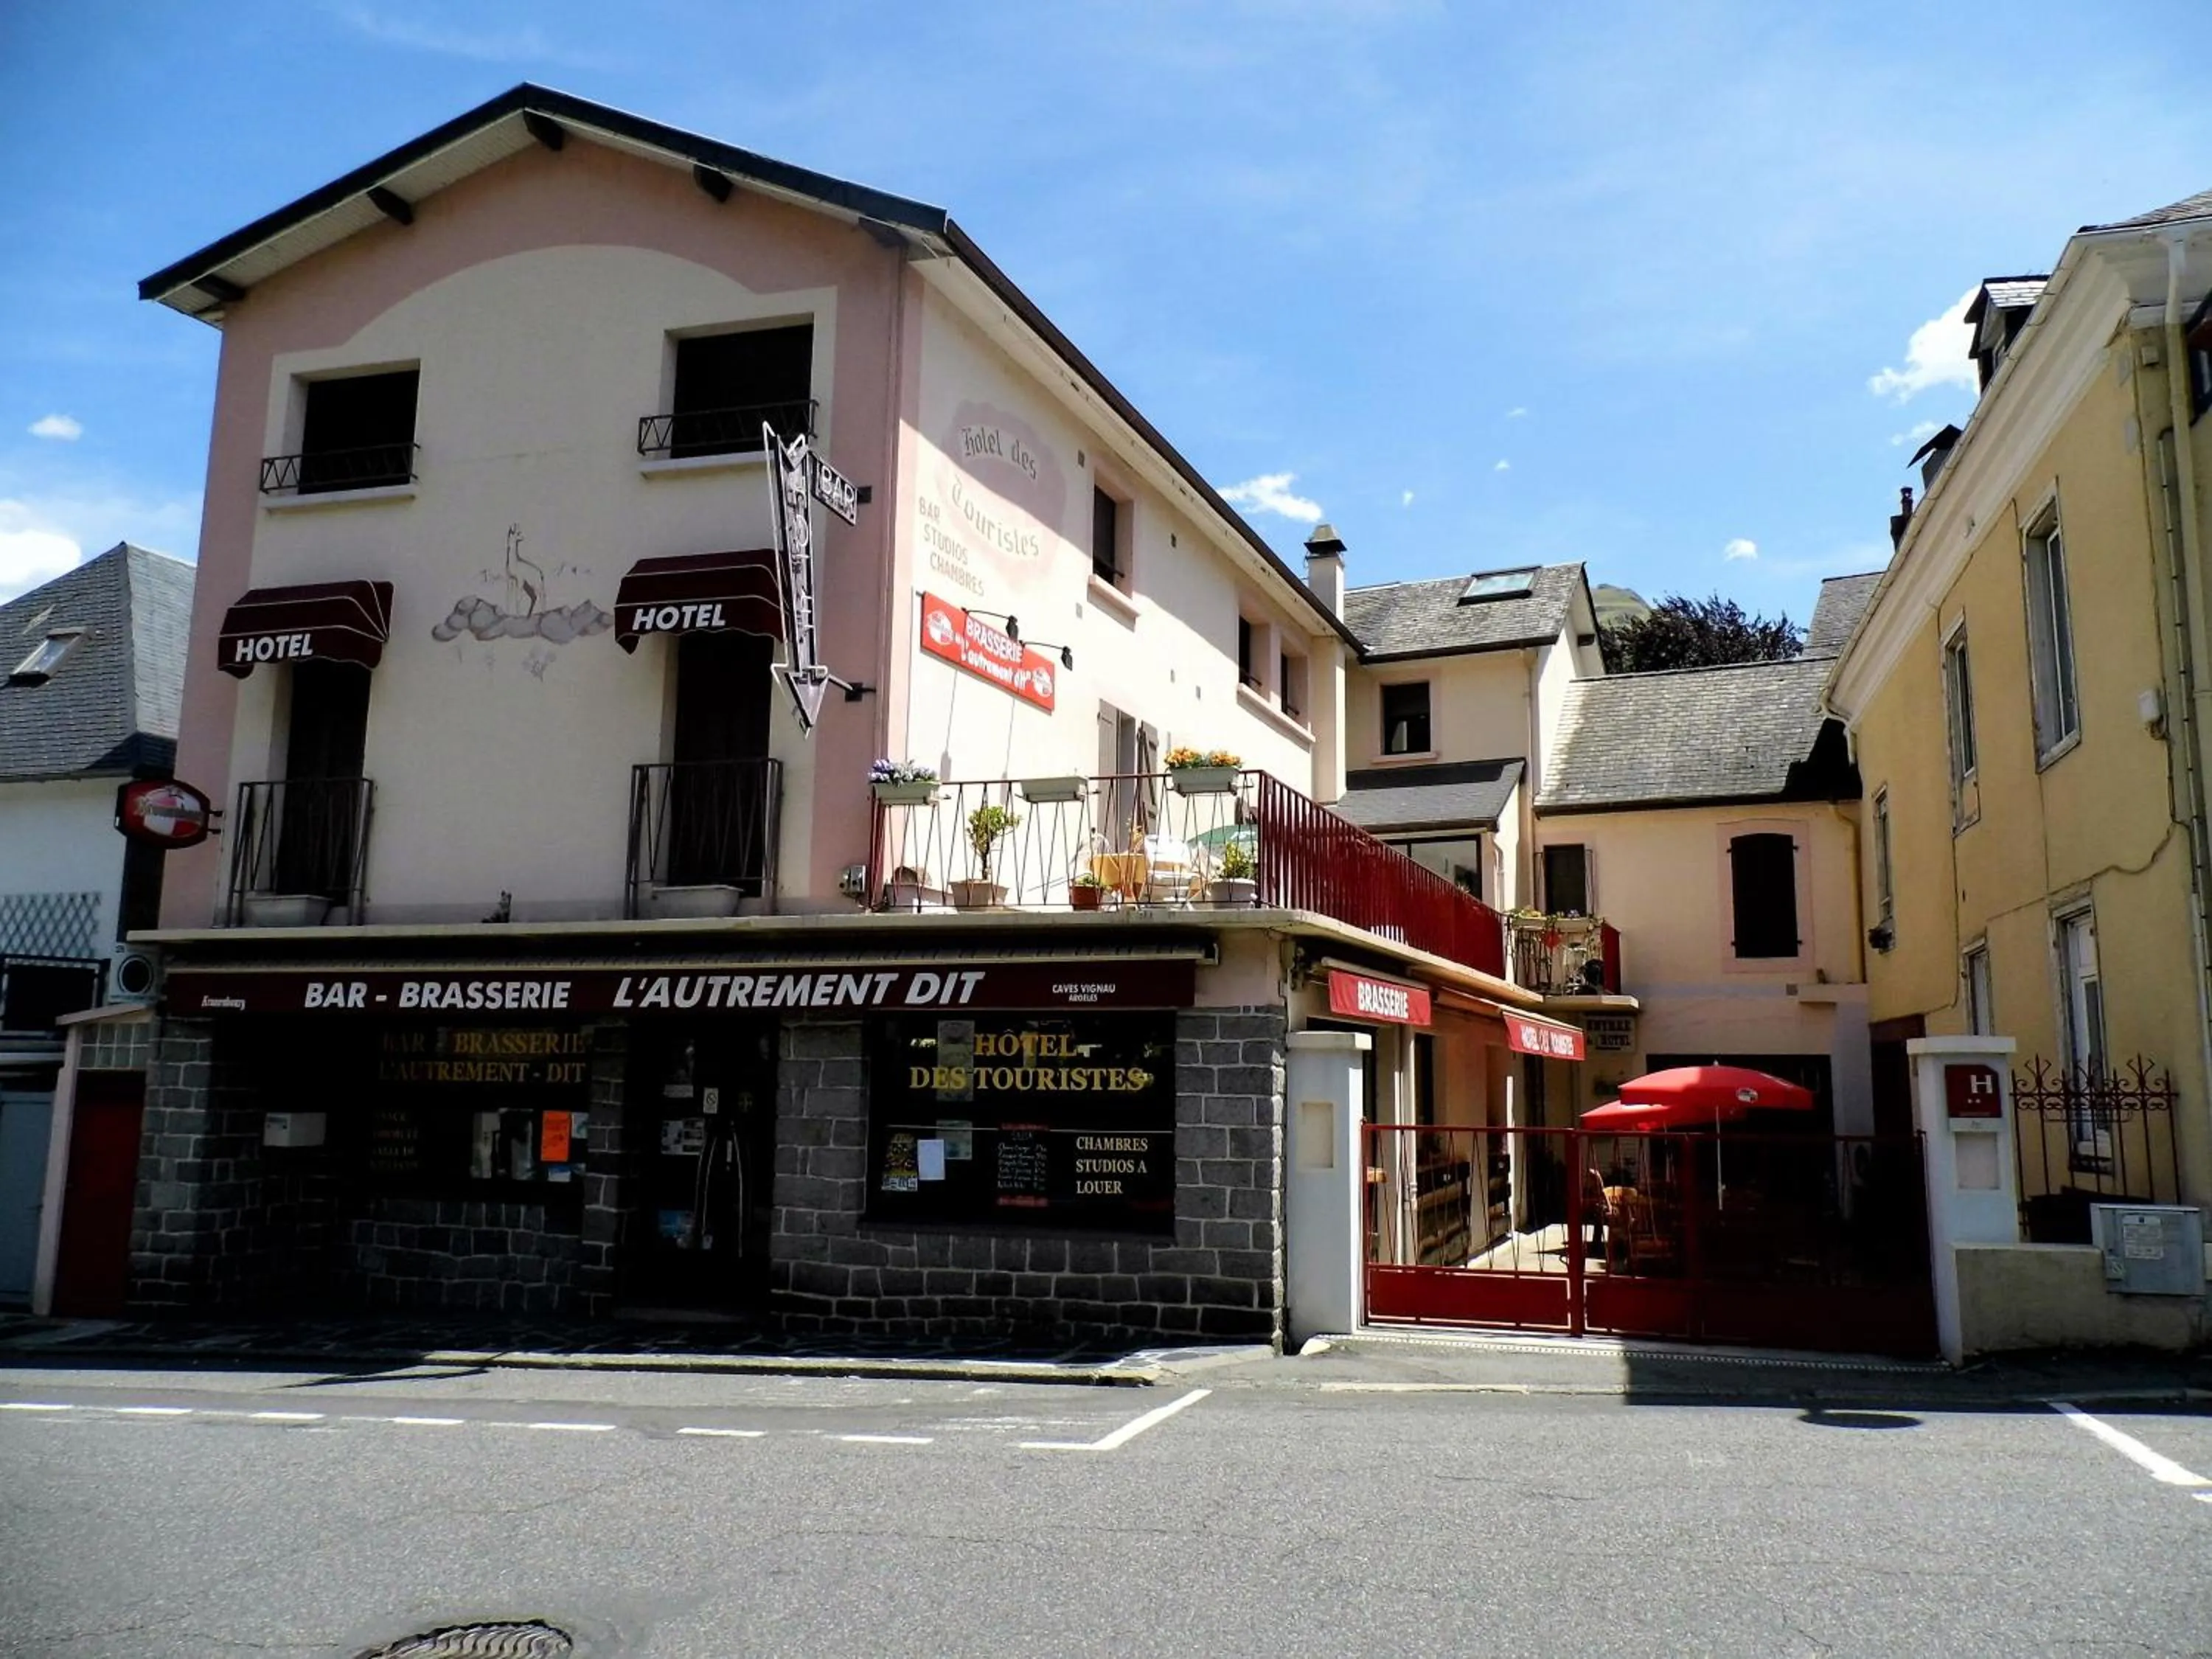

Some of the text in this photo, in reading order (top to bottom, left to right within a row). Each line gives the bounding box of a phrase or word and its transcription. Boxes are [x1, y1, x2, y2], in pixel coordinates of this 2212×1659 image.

[1011, 439, 1037, 479] des
[821, 465, 855, 514] BAR
[919, 495, 940, 524] BAR
[923, 523, 968, 566] STUDIOS
[930, 552, 984, 597] CHAMBRES
[632, 604, 726, 630] HOTEL
[234, 633, 313, 663] HOTEL
[966, 618, 1023, 663] BRASSERIE
[304, 981, 368, 1009] BAR
[399, 981, 571, 1009] BRASSERIE
[613, 973, 900, 1008] L'AUTREMENT
[904, 971, 986, 1004] DIT
[1052, 983, 1116, 993] CAVES VIGNAU
[1357, 980, 1408, 1019] BRASSERIE
[453, 1030, 588, 1054] BRASSERIE
[973, 1029, 1079, 1057] HÔTEL
[546, 1061, 587, 1083] DIT
[909, 1066, 1145, 1092] DES TOURISTES
[1970, 1074, 1993, 1094] H
[1076, 1136, 1148, 1152] CHAMBRES
[1076, 1158, 1147, 1174] STUDIOS A
[1077, 1180, 1123, 1194] LOUER
